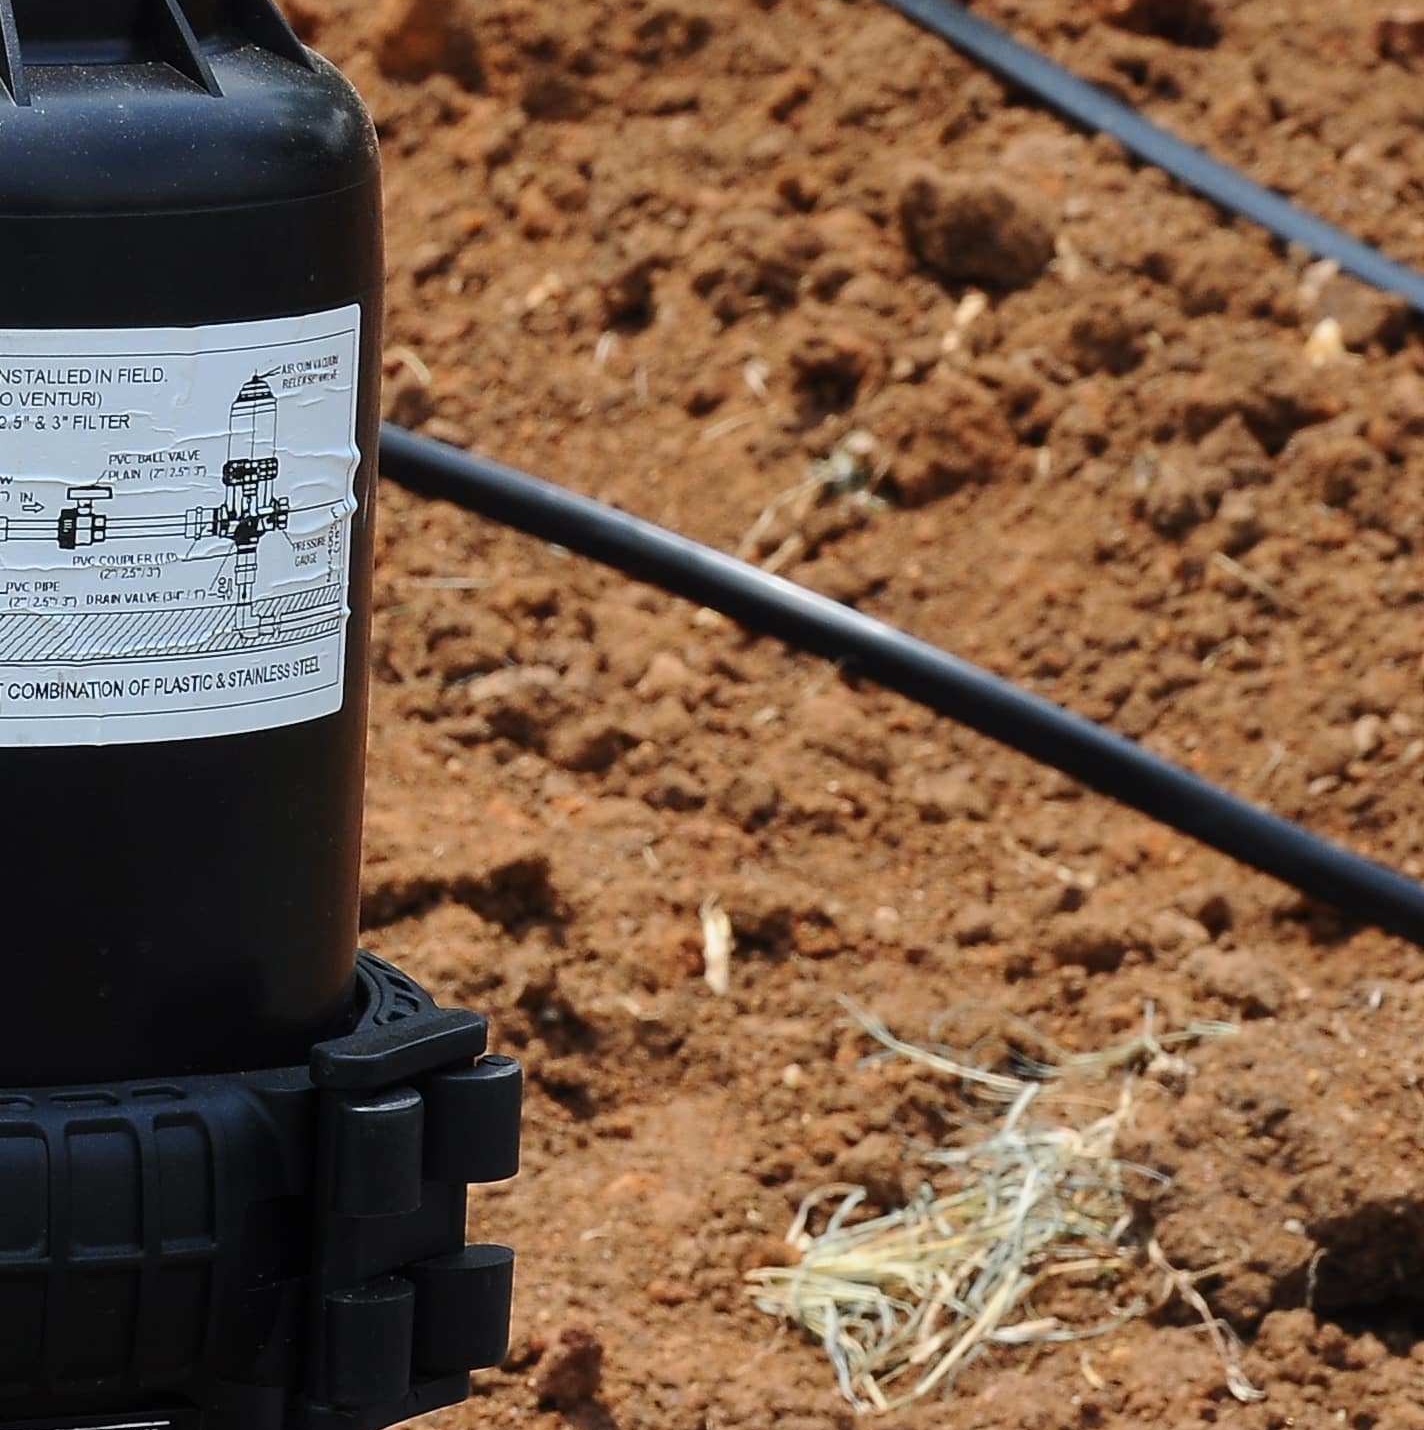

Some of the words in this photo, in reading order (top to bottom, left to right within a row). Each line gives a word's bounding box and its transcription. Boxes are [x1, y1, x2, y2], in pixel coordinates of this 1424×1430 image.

[95, 369, 112, 383] IN
[118, 367, 168, 383] FIELD.
[19, 391, 102, 408] VENTURI)
[34, 416, 46, 430] &
[51, 415, 68, 429] 3"
[73, 415, 130, 429] FILTER
[109, 454, 134, 465] PVC
[169, 450, 200, 461] VALVE
[20, 492, 33, 503] IN
[6, 582, 29, 592] PVC
[35, 581, 60, 591] PIPE
[87, 594, 121, 605] DRAIN
[126, 592, 159, 603] VALVE
[7, 680, 123, 700] COMBINATION
[128, 678, 151, 696] OF
[154, 675, 212, 696] PLASTIC
[217, 673, 226, 689] &
[228, 662, 290, 689] STAINLESS
[292, 655, 321, 677] STEEL
